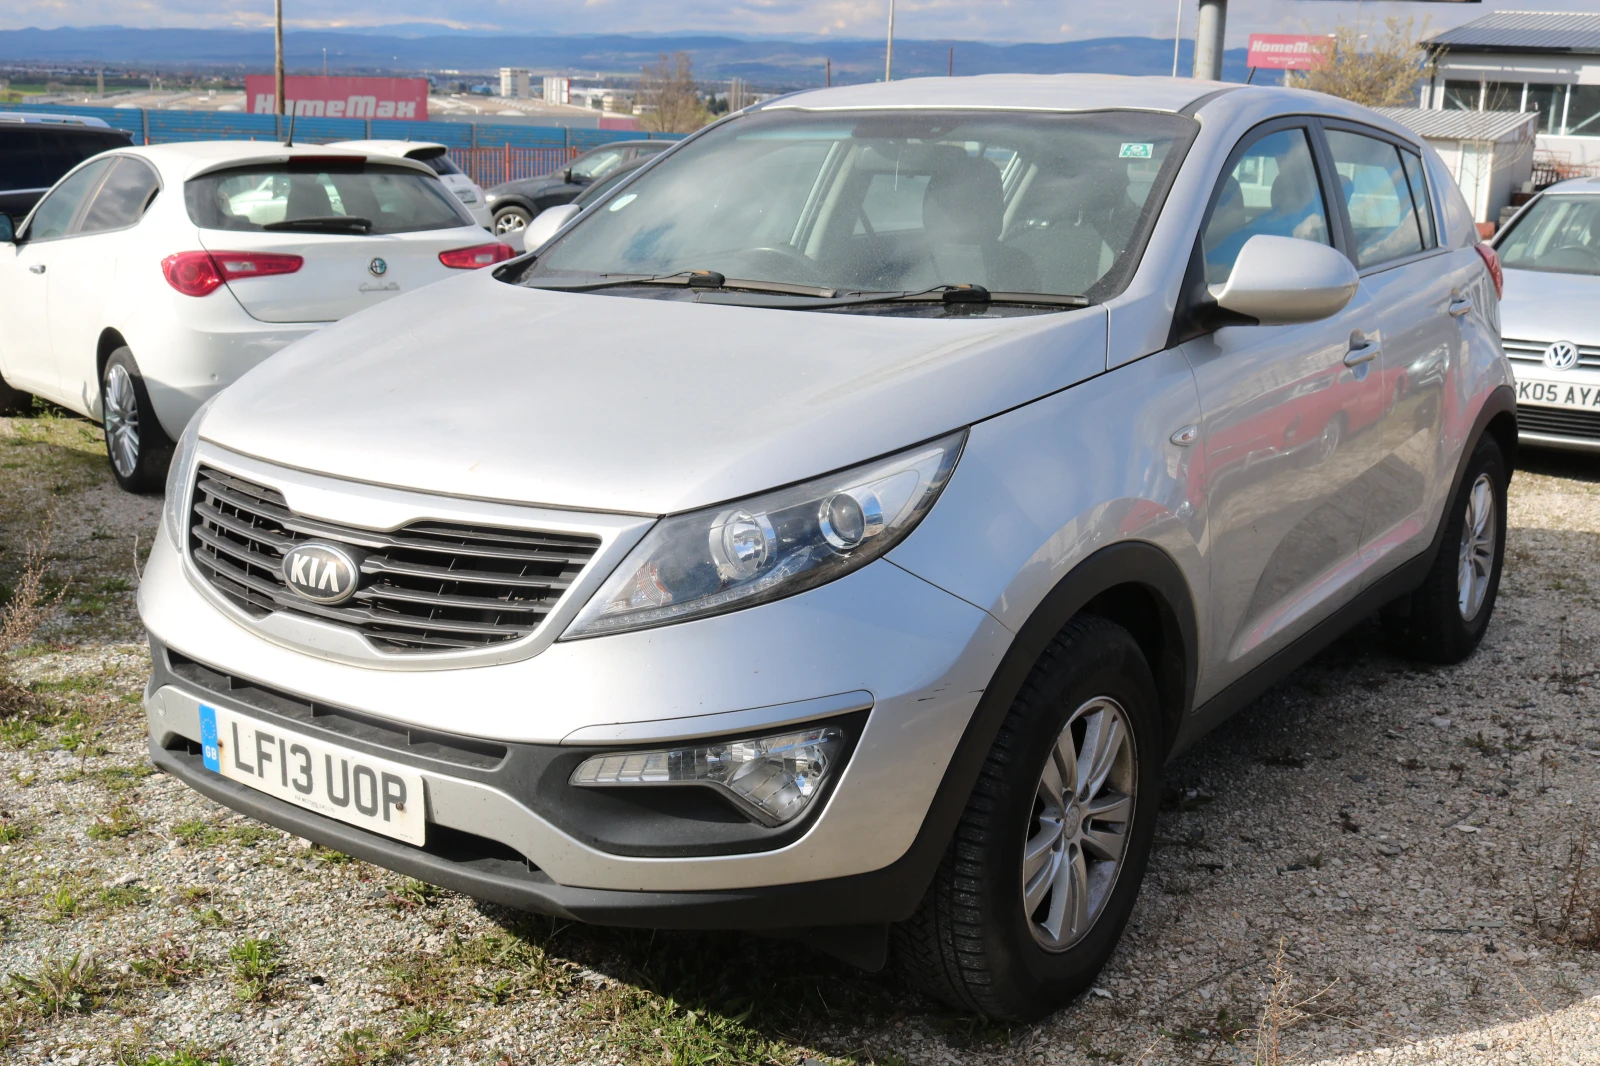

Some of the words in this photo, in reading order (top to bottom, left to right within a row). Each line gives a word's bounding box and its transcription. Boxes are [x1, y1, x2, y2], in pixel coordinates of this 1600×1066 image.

[1251, 40, 1327, 54] HomeM
[1515, 381, 1558, 402] K05
[1564, 386, 1600, 406] AYA
[290, 553, 340, 593] KIA
[205, 745, 217, 760] GB
[231, 721, 314, 796] LF13
[325, 753, 408, 822] UOP
